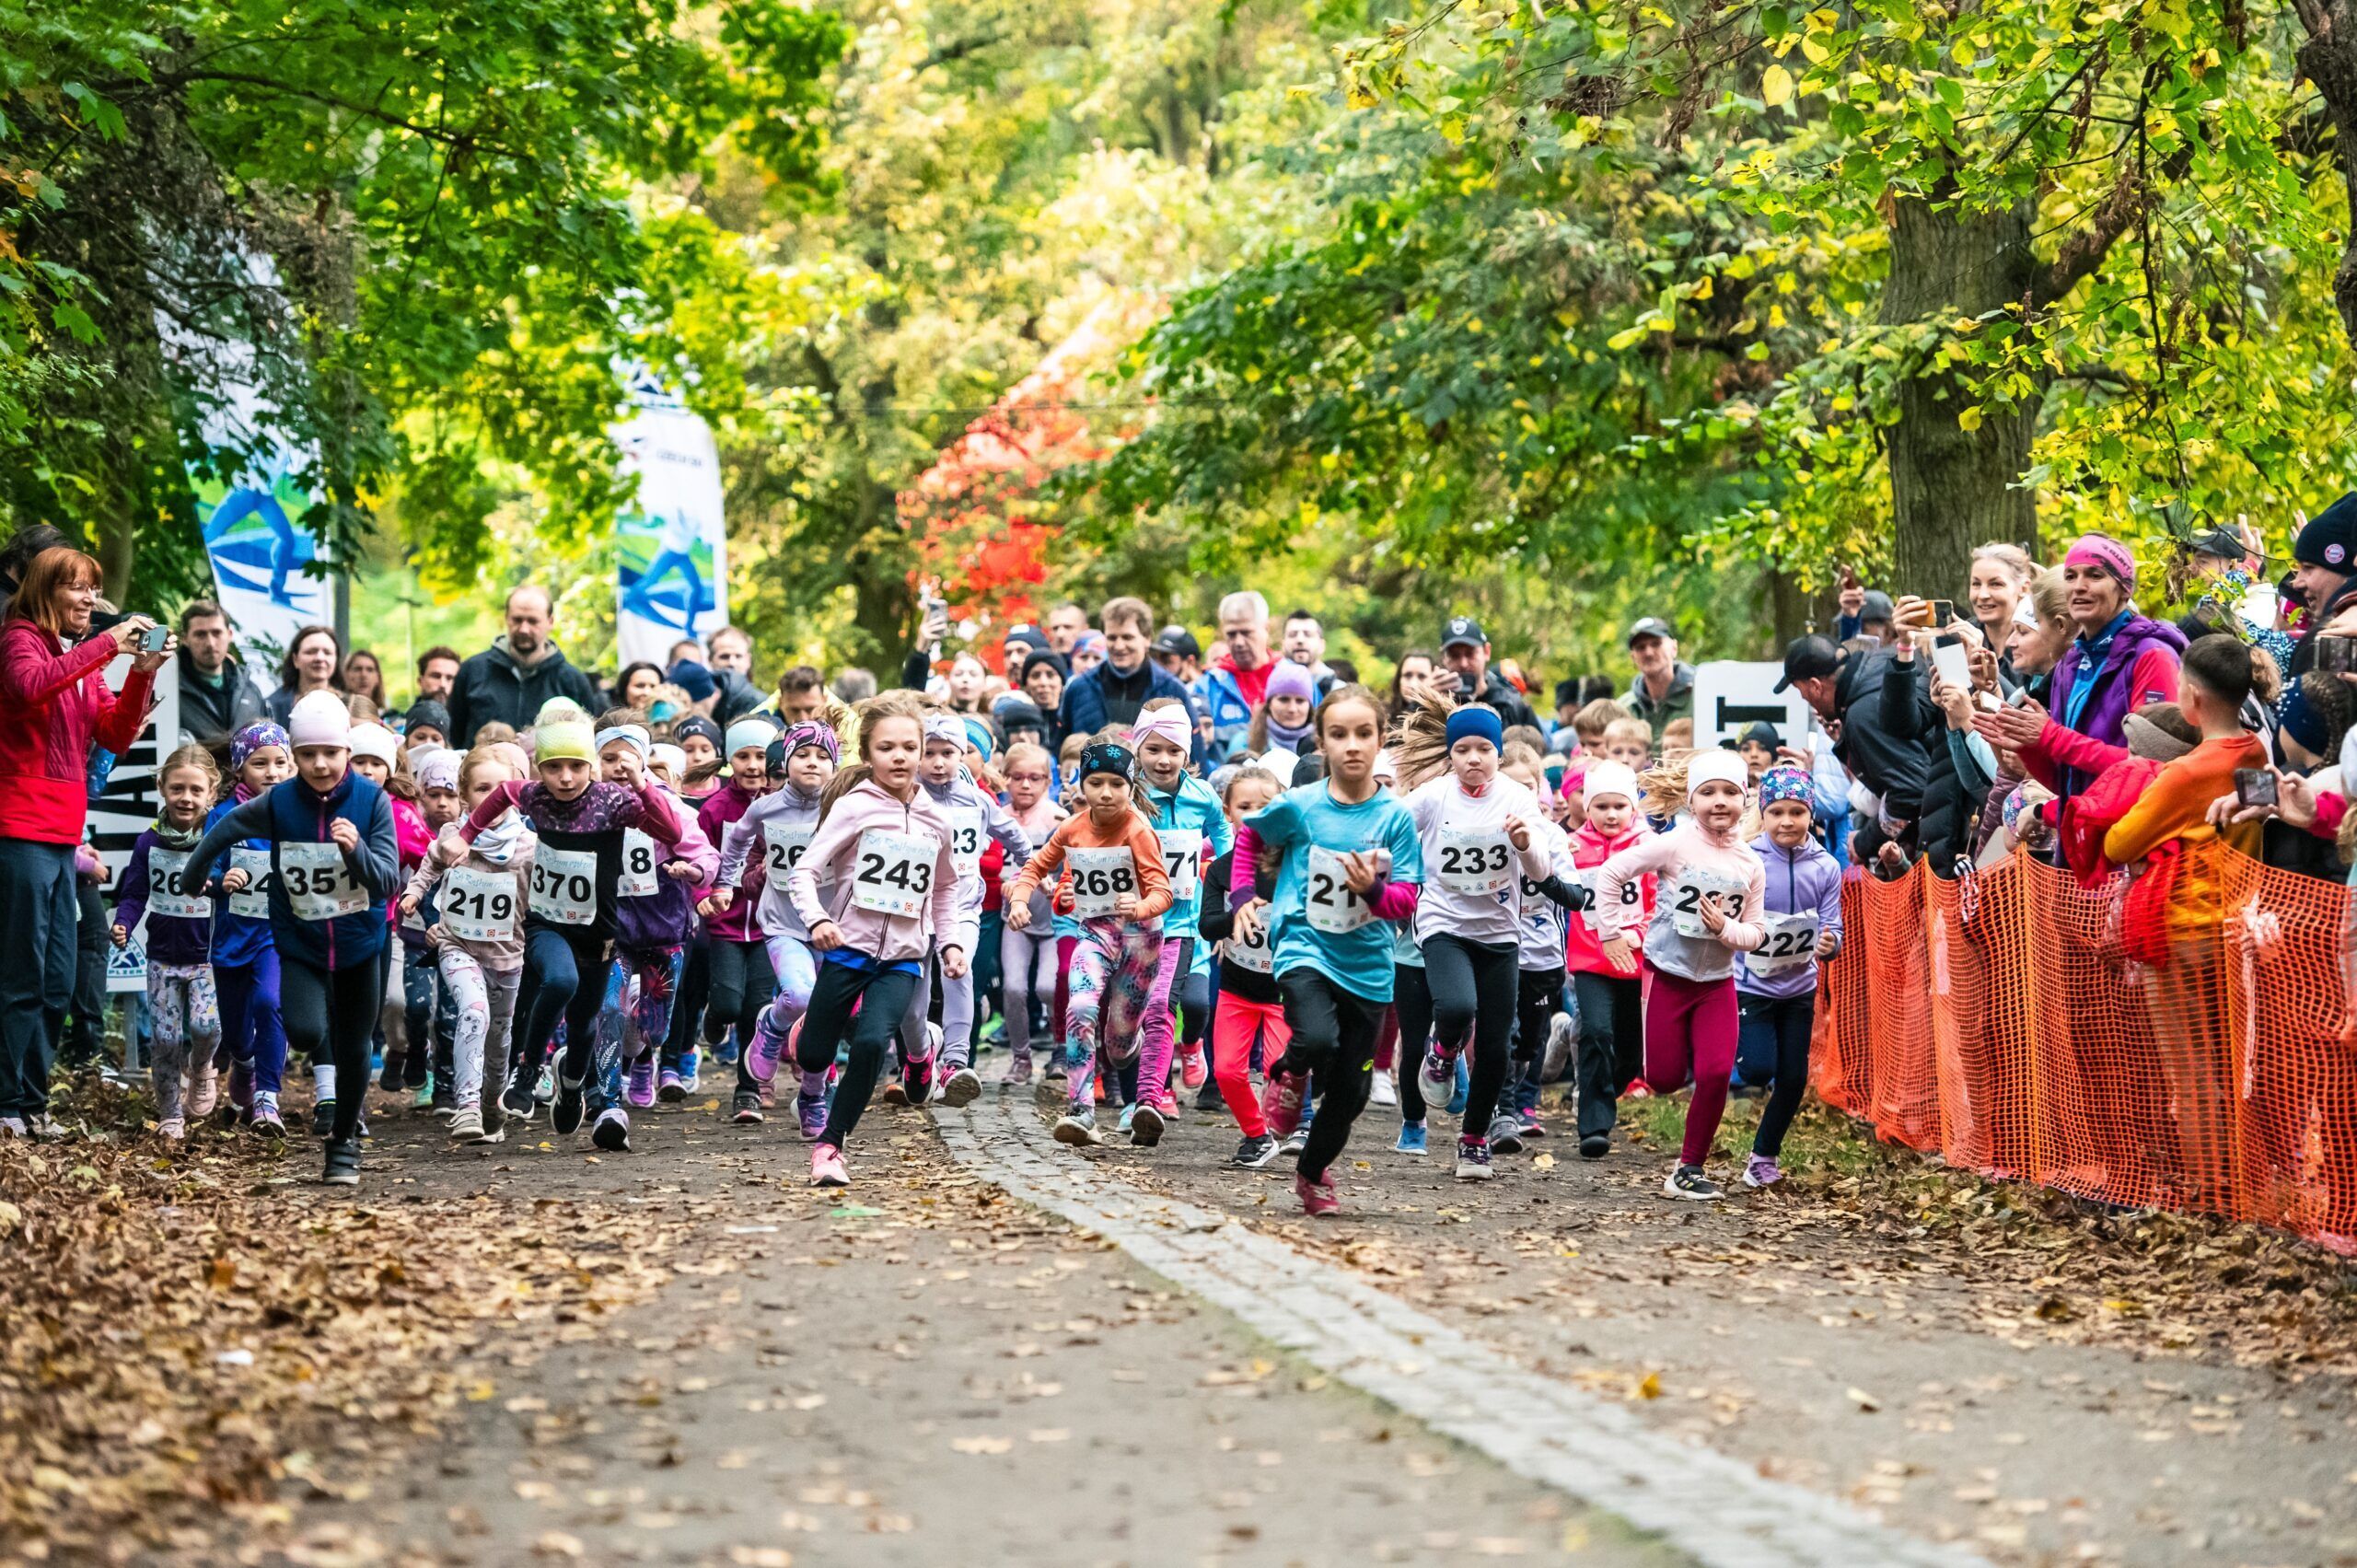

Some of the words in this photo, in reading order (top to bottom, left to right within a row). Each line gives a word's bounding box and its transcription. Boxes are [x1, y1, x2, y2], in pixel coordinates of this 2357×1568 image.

[770, 843, 832, 871] 26
[1441, 843, 1509, 875] 233
[285, 866, 359, 897] 351
[532, 863, 592, 903] 370
[857, 853, 932, 894] 243
[1071, 867, 1134, 897] 268
[447, 887, 512, 921] 219
[1311, 872, 1387, 909] 21
[1583, 881, 1639, 912] 28
[1749, 928, 1815, 958] 222
